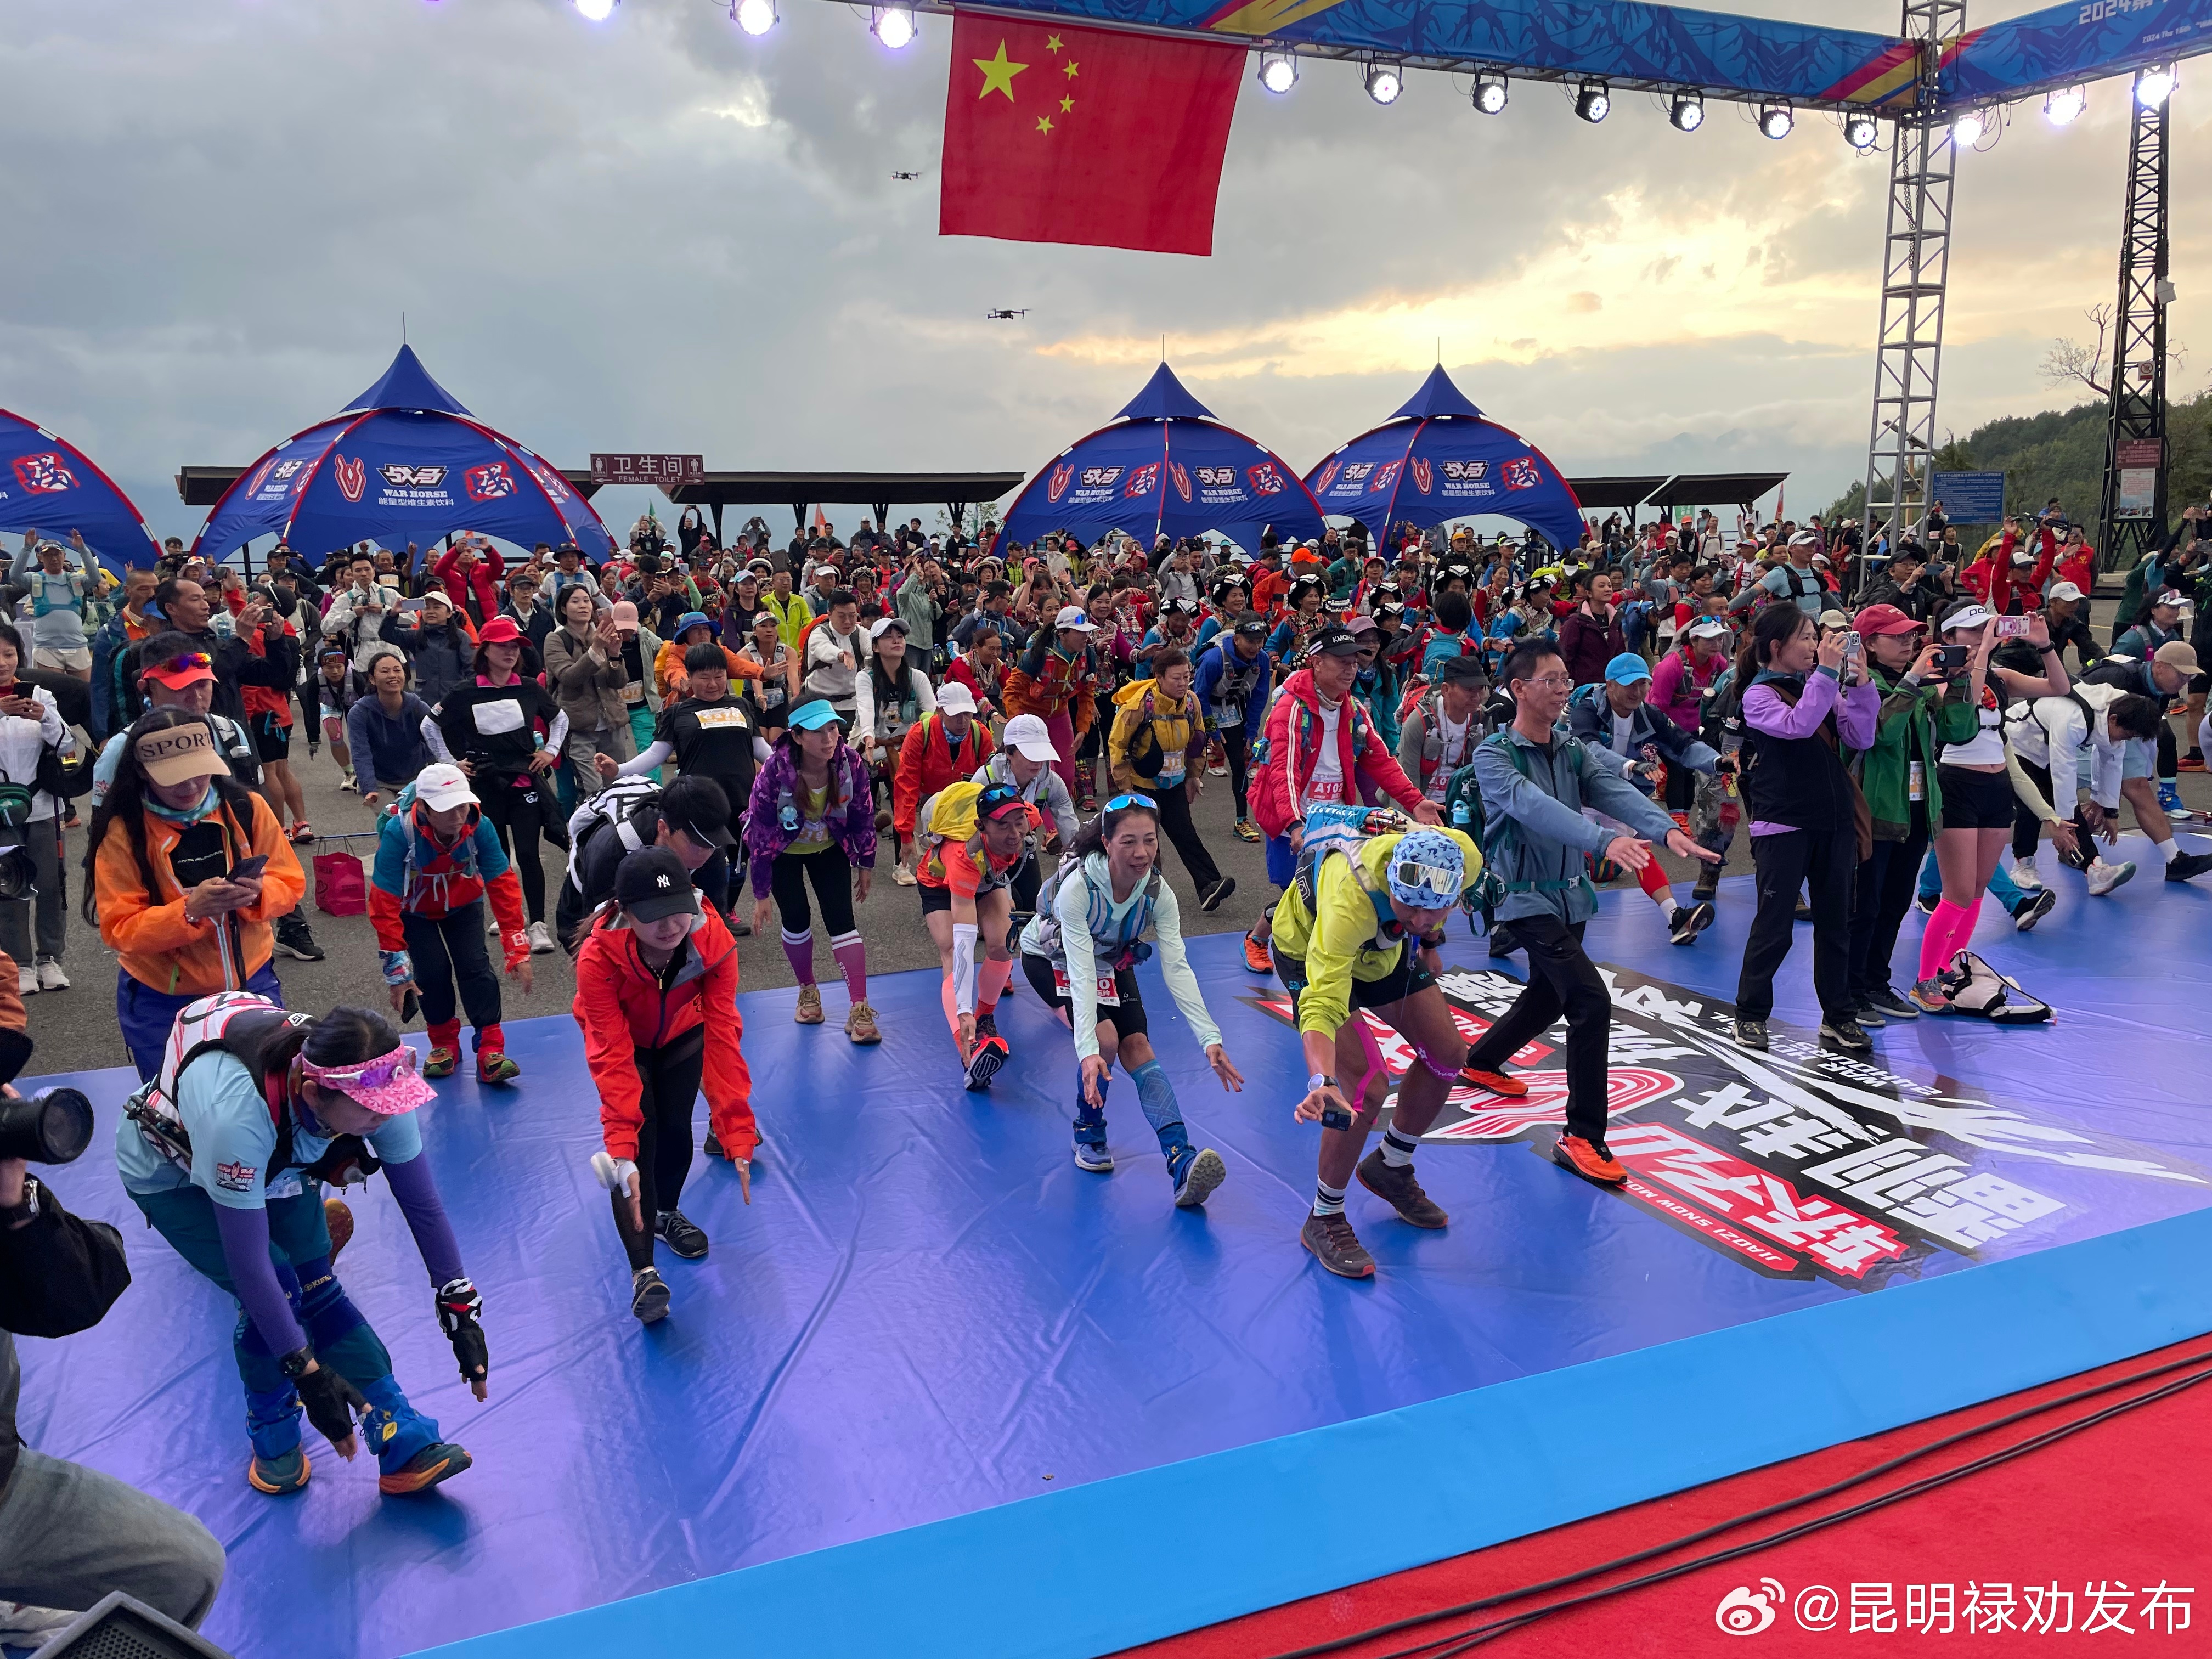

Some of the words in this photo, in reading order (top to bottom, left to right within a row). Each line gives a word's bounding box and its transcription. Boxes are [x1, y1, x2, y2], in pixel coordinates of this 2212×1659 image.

[383, 465, 445, 486] 战马
[613, 456, 682, 476] 卫生间
[378, 496, 454, 506] 能量型维生素饮料
[383, 489, 408, 498] WAR
[409, 490, 448, 498] HORSE
[140, 733, 212, 758] SPORT
[657, 874, 670, 888] NY
[1816, 1063, 1887, 1087] WAR
[1656, 1199, 1714, 1228] SNOW
[1712, 1228, 1782, 1262] JIAOZI
